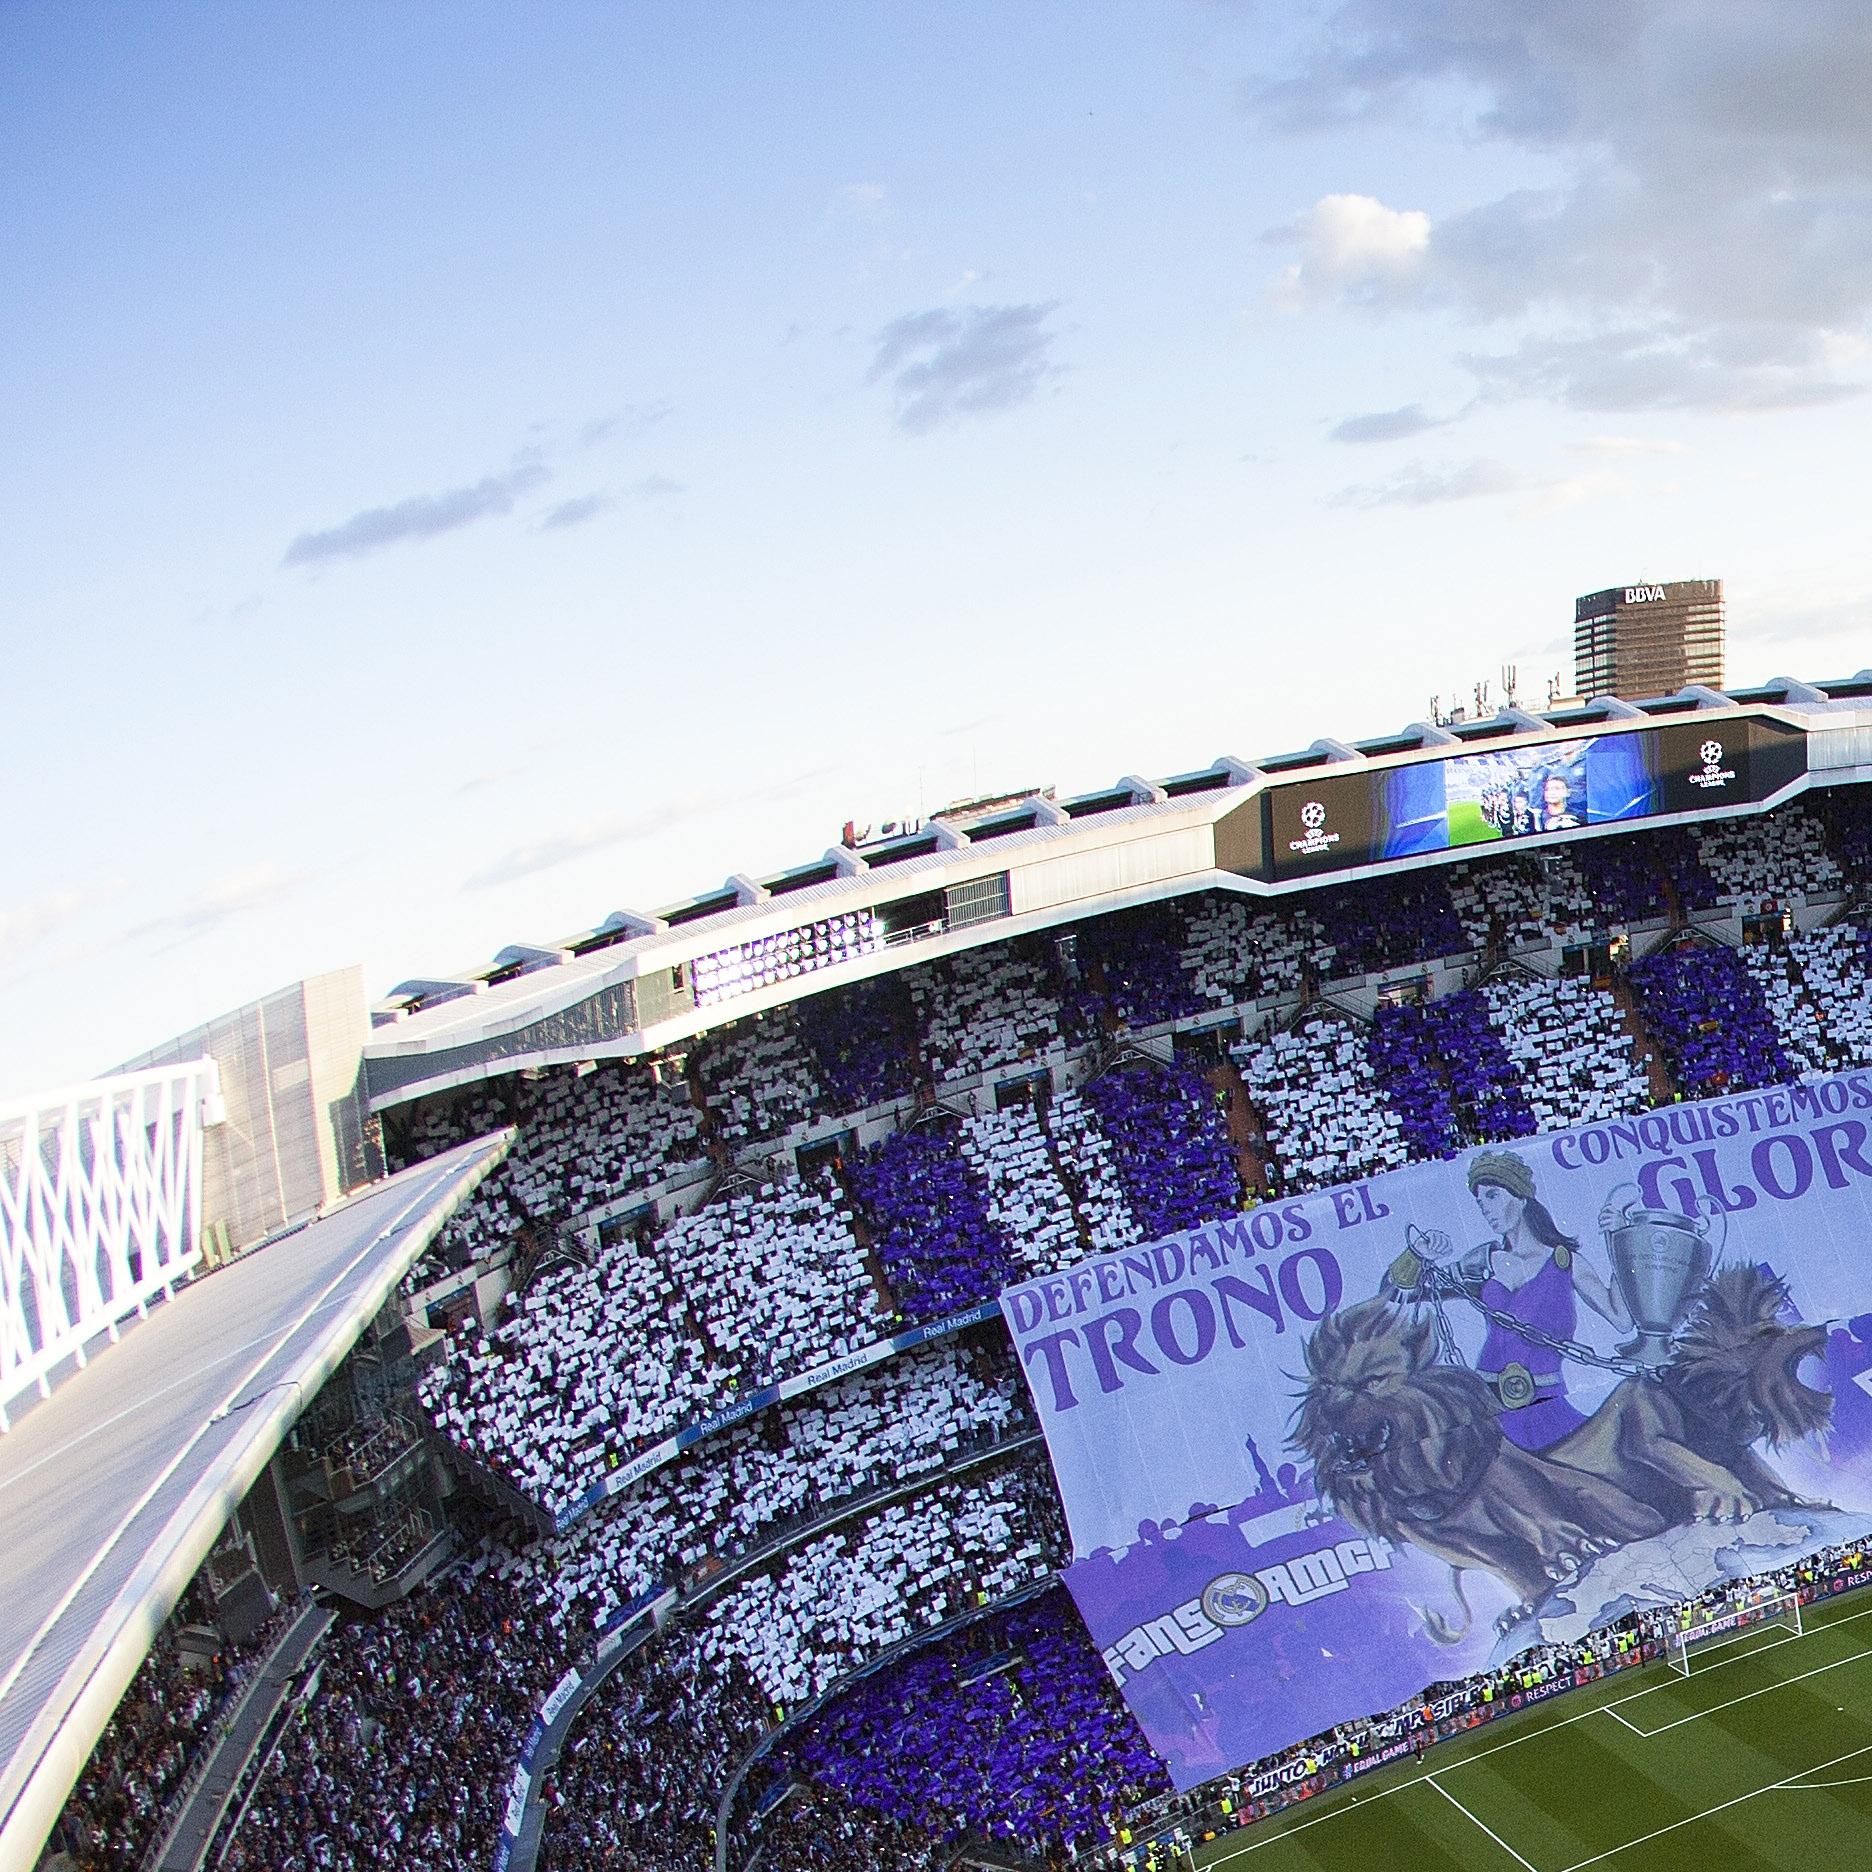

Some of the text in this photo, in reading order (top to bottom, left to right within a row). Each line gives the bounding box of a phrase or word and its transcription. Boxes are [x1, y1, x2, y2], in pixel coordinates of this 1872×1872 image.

[1625, 585, 1666, 604] BBVA
[1689, 769, 1735, 784] CHAMPIONS
[1290, 833, 1339, 849] CHAMPIONS
[1007, 1183, 1391, 1334] DEFENDAMOS EL
[924, 1310, 980, 1339] Real Madrid
[1024, 1247, 1344, 1412] TRONO
[808, 1354, 867, 1386] Real Madrid
[700, 1401, 753, 1435] Real Madrid
[616, 1452, 663, 1487] Real Madrid
[1525, 1677, 1573, 1701] RESPECT
